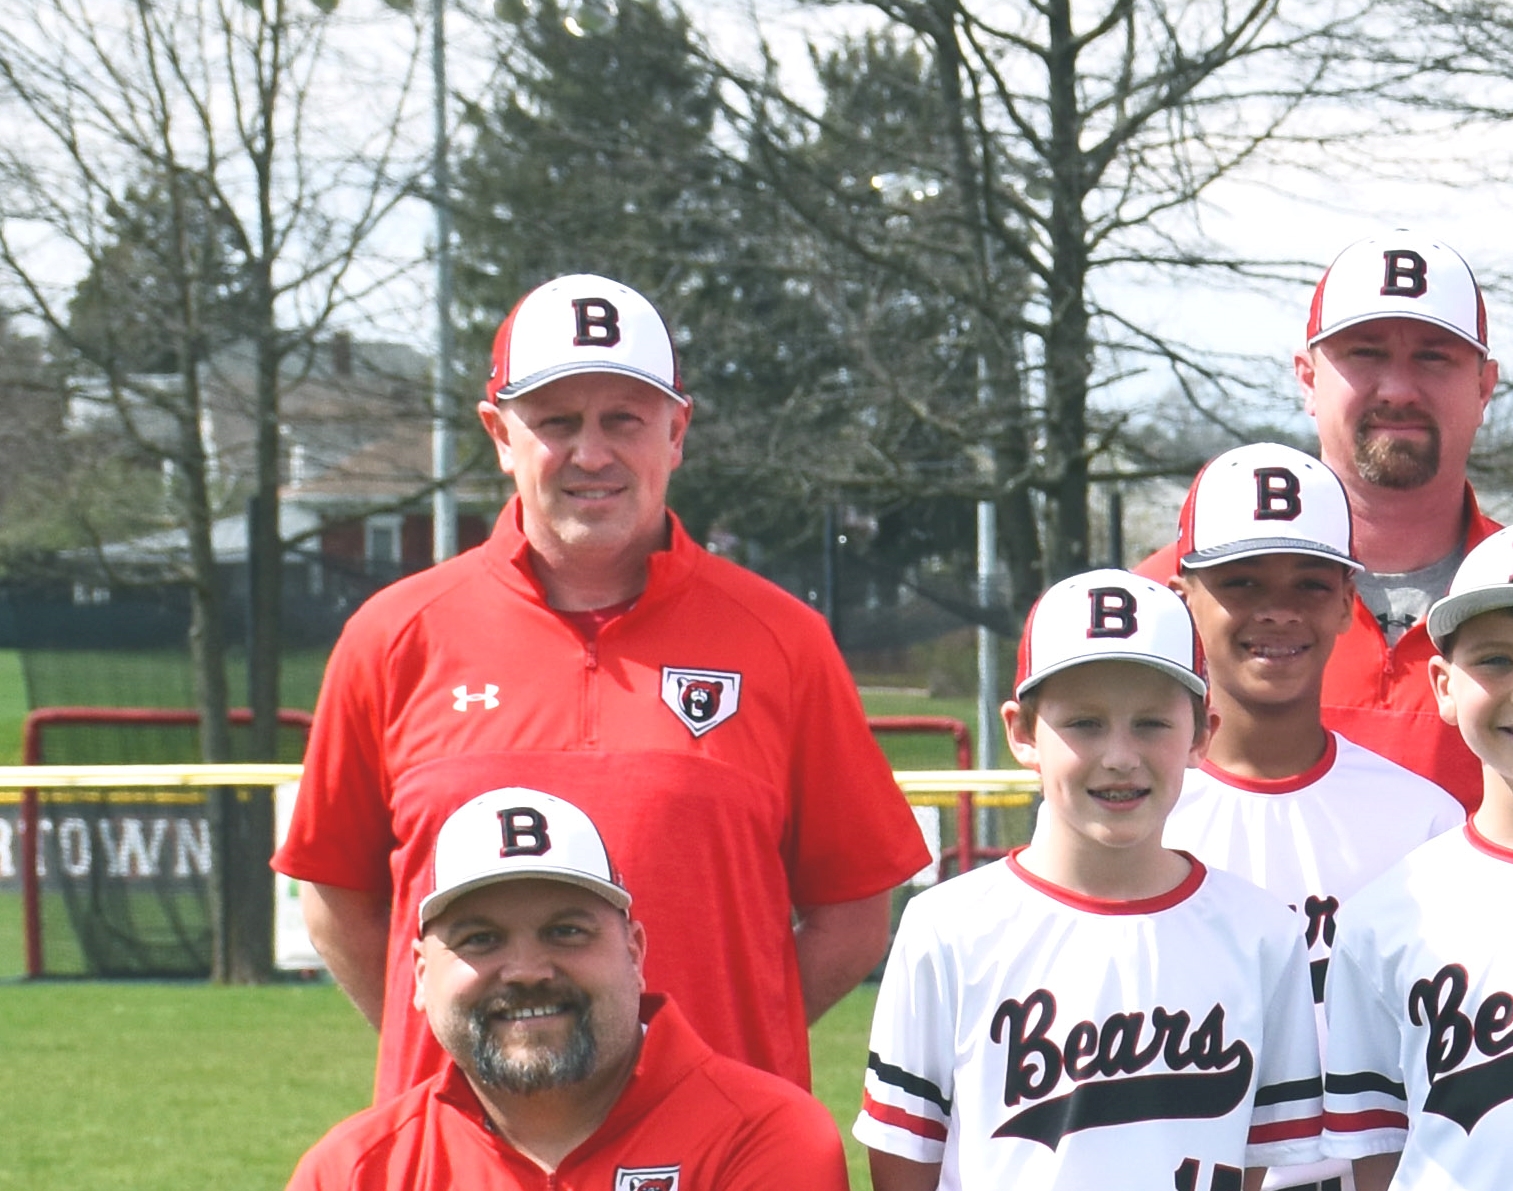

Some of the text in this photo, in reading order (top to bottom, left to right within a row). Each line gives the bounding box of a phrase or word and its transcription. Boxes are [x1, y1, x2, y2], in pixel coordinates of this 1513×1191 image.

[1379, 249, 1428, 299] B
[571, 297, 621, 348] B
[1253, 466, 1302, 522] B
[1086, 586, 1138, 639] B
[496, 806, 552, 859] B
[990, 988, 1254, 1107] Bears
